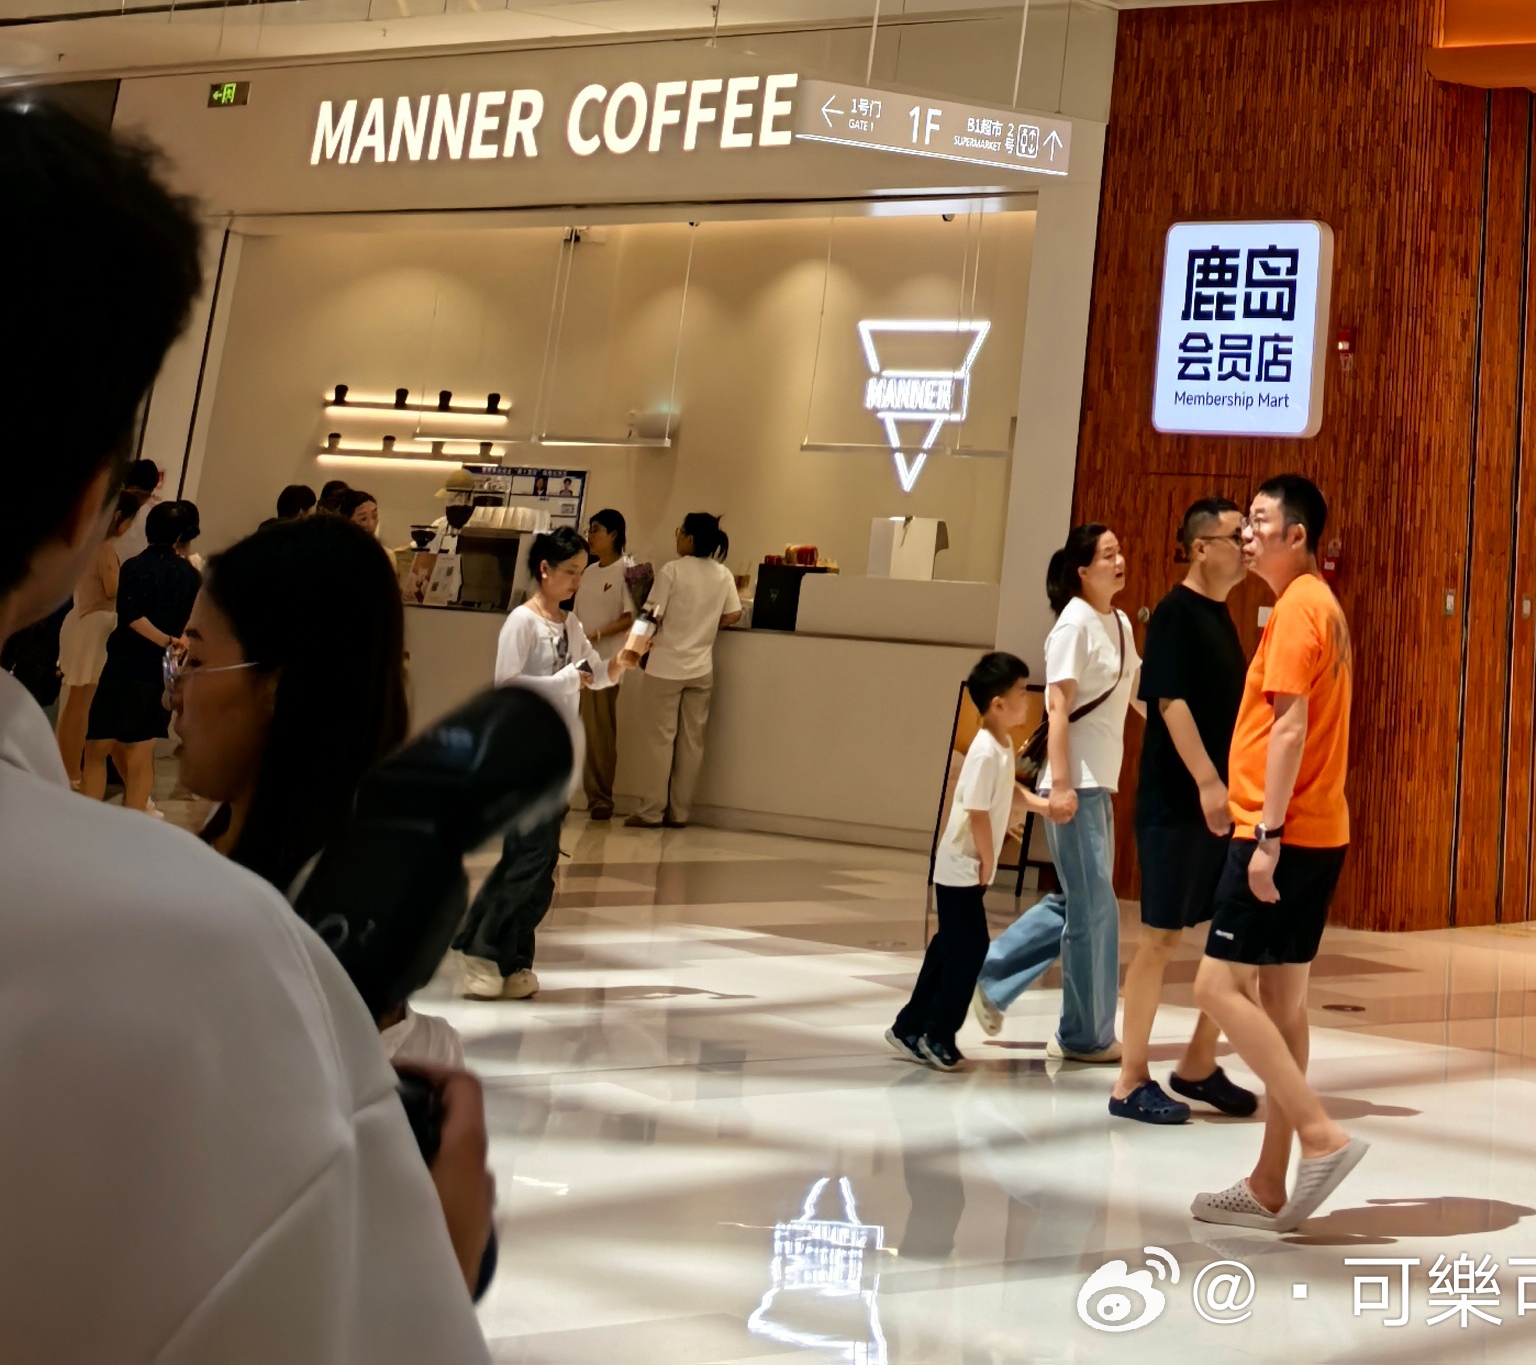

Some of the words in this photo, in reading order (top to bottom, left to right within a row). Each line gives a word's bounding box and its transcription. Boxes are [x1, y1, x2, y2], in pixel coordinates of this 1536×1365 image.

[310, 89, 543, 165] MANNER
[566, 73, 800, 155] COFFEE
[851, 99, 882, 118] 1号门
[849, 120, 867, 132] GATE
[909, 106, 943, 145] 1F
[967, 118, 1002, 137] B1超市
[954, 135, 1002, 151] SUPERMARKET
[1181, 245, 1299, 321] 鹿岛
[1177, 332, 1293, 383] 会员店
[866, 378, 954, 409] MANNER
[1174, 391, 1254, 410] Membership
[1258, 393, 1290, 408] Mart
